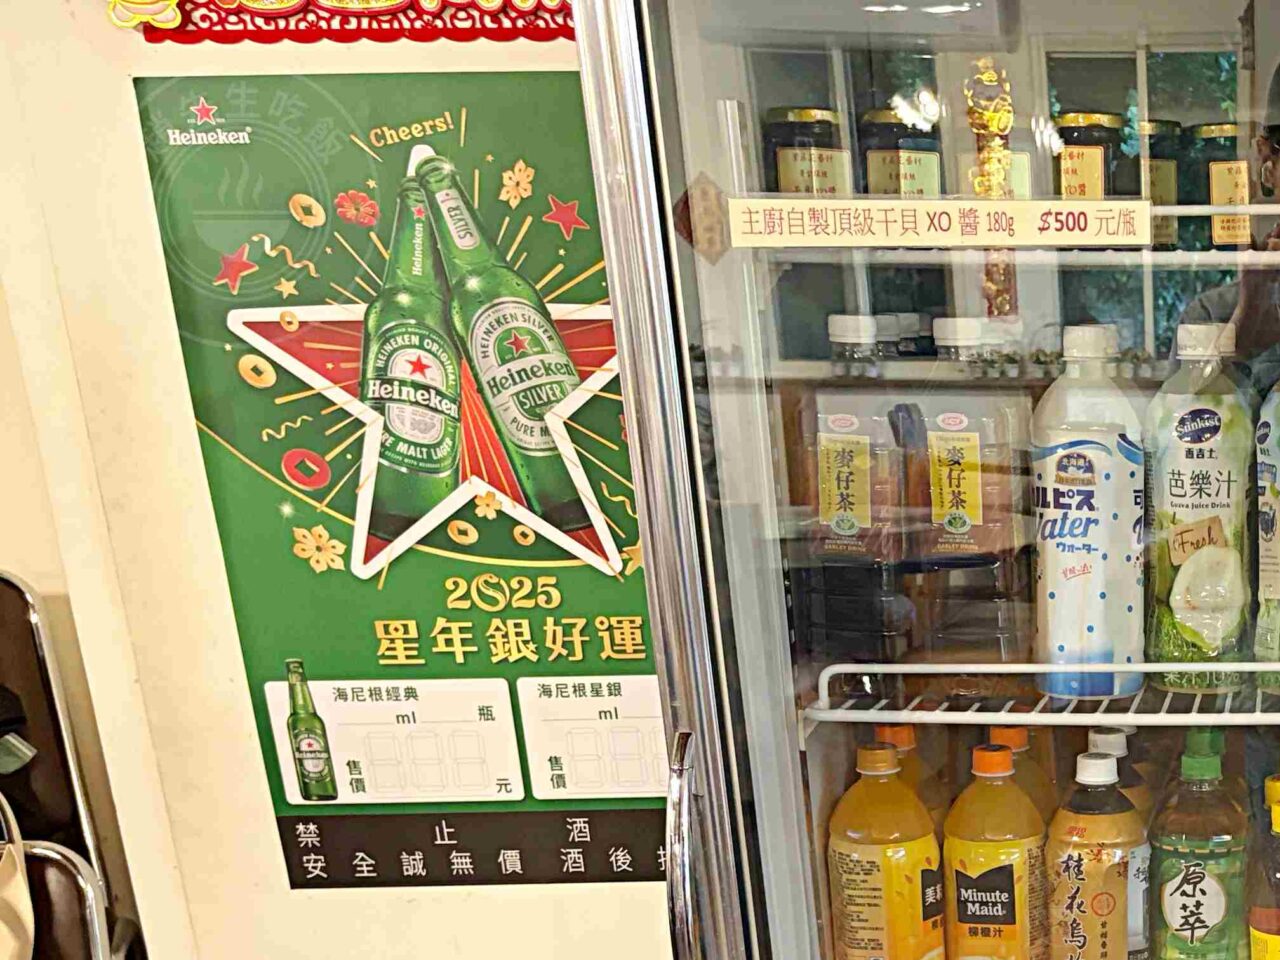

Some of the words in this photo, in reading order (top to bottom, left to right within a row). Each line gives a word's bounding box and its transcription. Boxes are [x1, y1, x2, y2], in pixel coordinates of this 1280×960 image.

[166, 128, 250, 145] Heineken
[370, 112, 455, 149] Cheers!
[447, 205, 473, 240] SILVER
[742, 208, 919, 237] 主廚自製頂級干貝
[926, 211, 951, 233] XO
[957, 208, 979, 236] 醬
[986, 211, 1015, 237] 180g
[1038, 211, 1087, 233] $500
[1094, 208, 1137, 237] 元/瓶
[412, 223, 423, 276] Heineken
[481, 312, 519, 359] HEINEKEN
[522, 314, 554, 342] SILVER
[376, 335, 420, 368] HEINEKEN
[424, 339, 457, 385] ORIGINAL
[486, 359, 576, 399] Heineken
[367, 379, 459, 419] Heineken
[520, 383, 563, 410] SILVER
[510, 416, 536, 437] PURE
[1176, 416, 1221, 433] Sunkist
[397, 443, 427, 459] MALT
[835, 448, 855, 512] 麥仔茶
[946, 446, 967, 511] 麥仔茶
[1167, 469, 1237, 499] 芭樂汁
[1032, 487, 1096, 511] ルピス
[1191, 502, 1209, 510] Juice
[1037, 511, 1100, 541] ater
[444, 573, 562, 611] 2025
[374, 615, 648, 666] 星年銀好運
[332, 685, 420, 703] 海尼根經典
[537, 683, 622, 699] 海尼根星銀
[395, 710, 417, 724] ml
[478, 705, 495, 722] 瓶
[598, 706, 619, 720] ml
[345, 759, 367, 794] 售價
[495, 777, 512, 794] 元
[547, 755, 567, 790] 售價
[960, 889, 1009, 903] Minute
[967, 903, 1003, 916] Maid
[1170, 862, 1210, 945] 原萃
